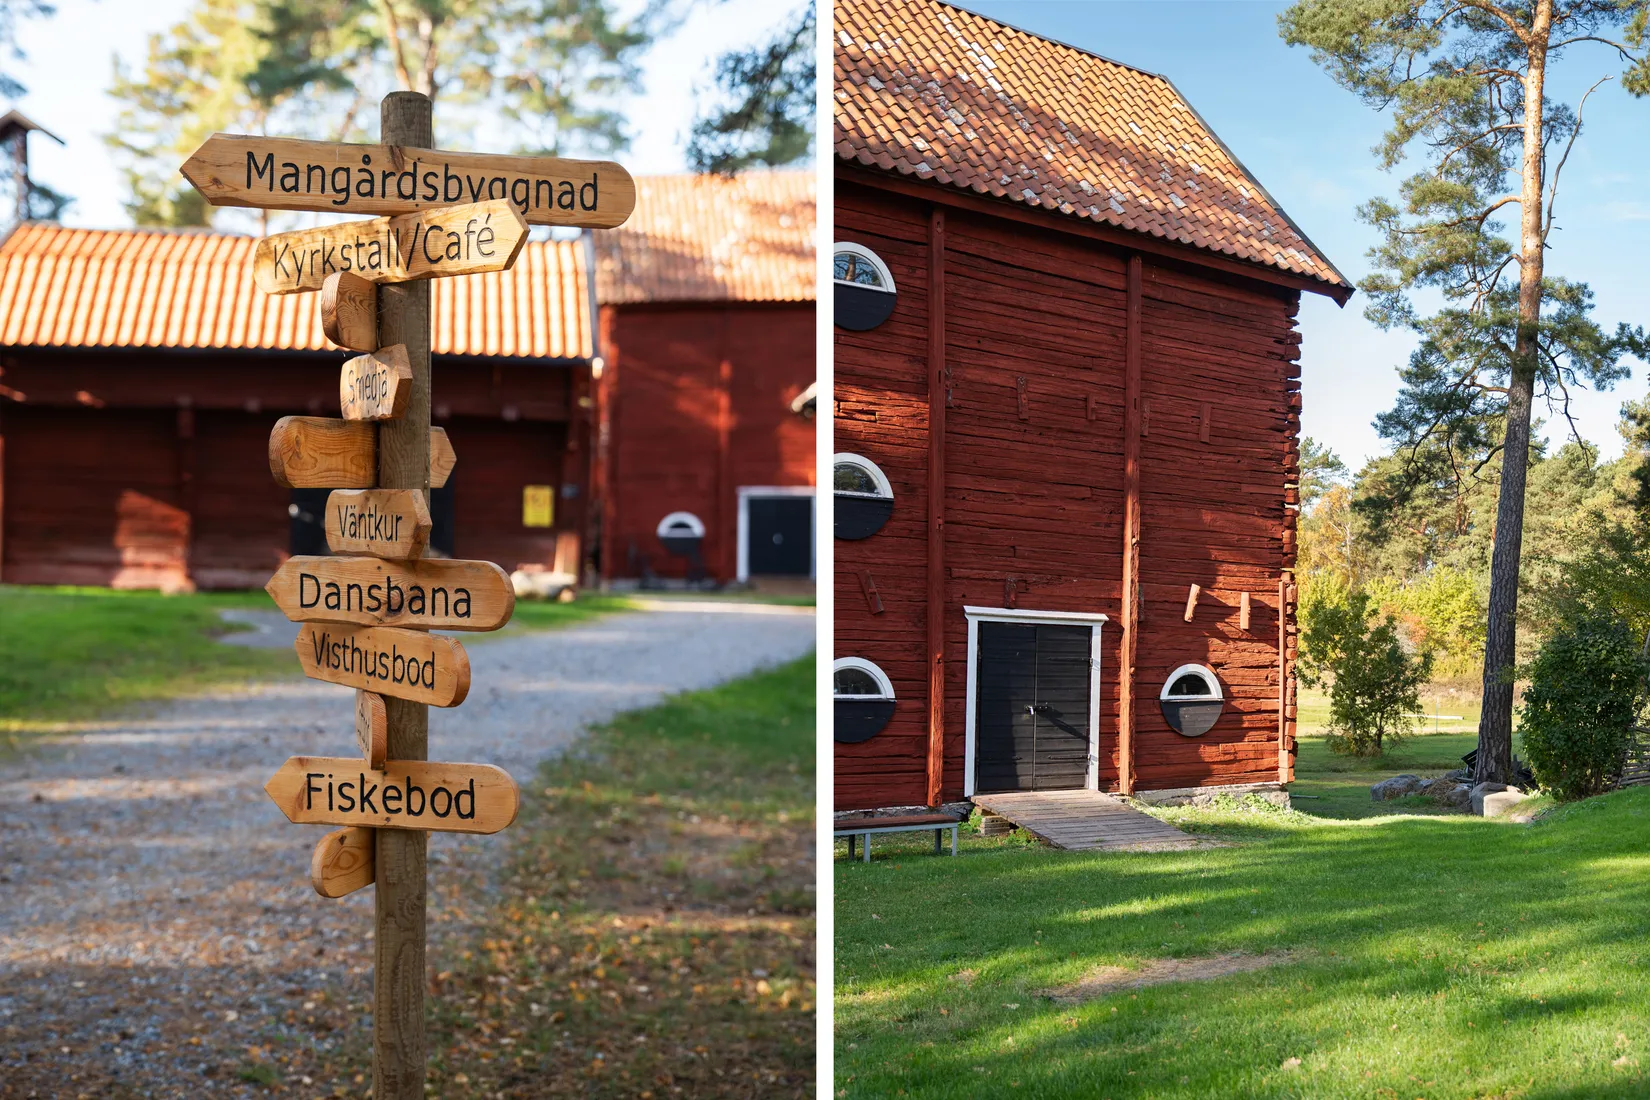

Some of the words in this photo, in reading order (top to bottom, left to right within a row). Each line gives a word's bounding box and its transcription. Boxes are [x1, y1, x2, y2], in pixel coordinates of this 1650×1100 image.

[273, 213, 496, 286] Kyrkstall/Café
[338, 504, 403, 542] Väntkur
[299, 573, 472, 618] Dansbana
[312, 631, 436, 691] Visthusbod
[306, 772, 476, 820] Fiskebod
